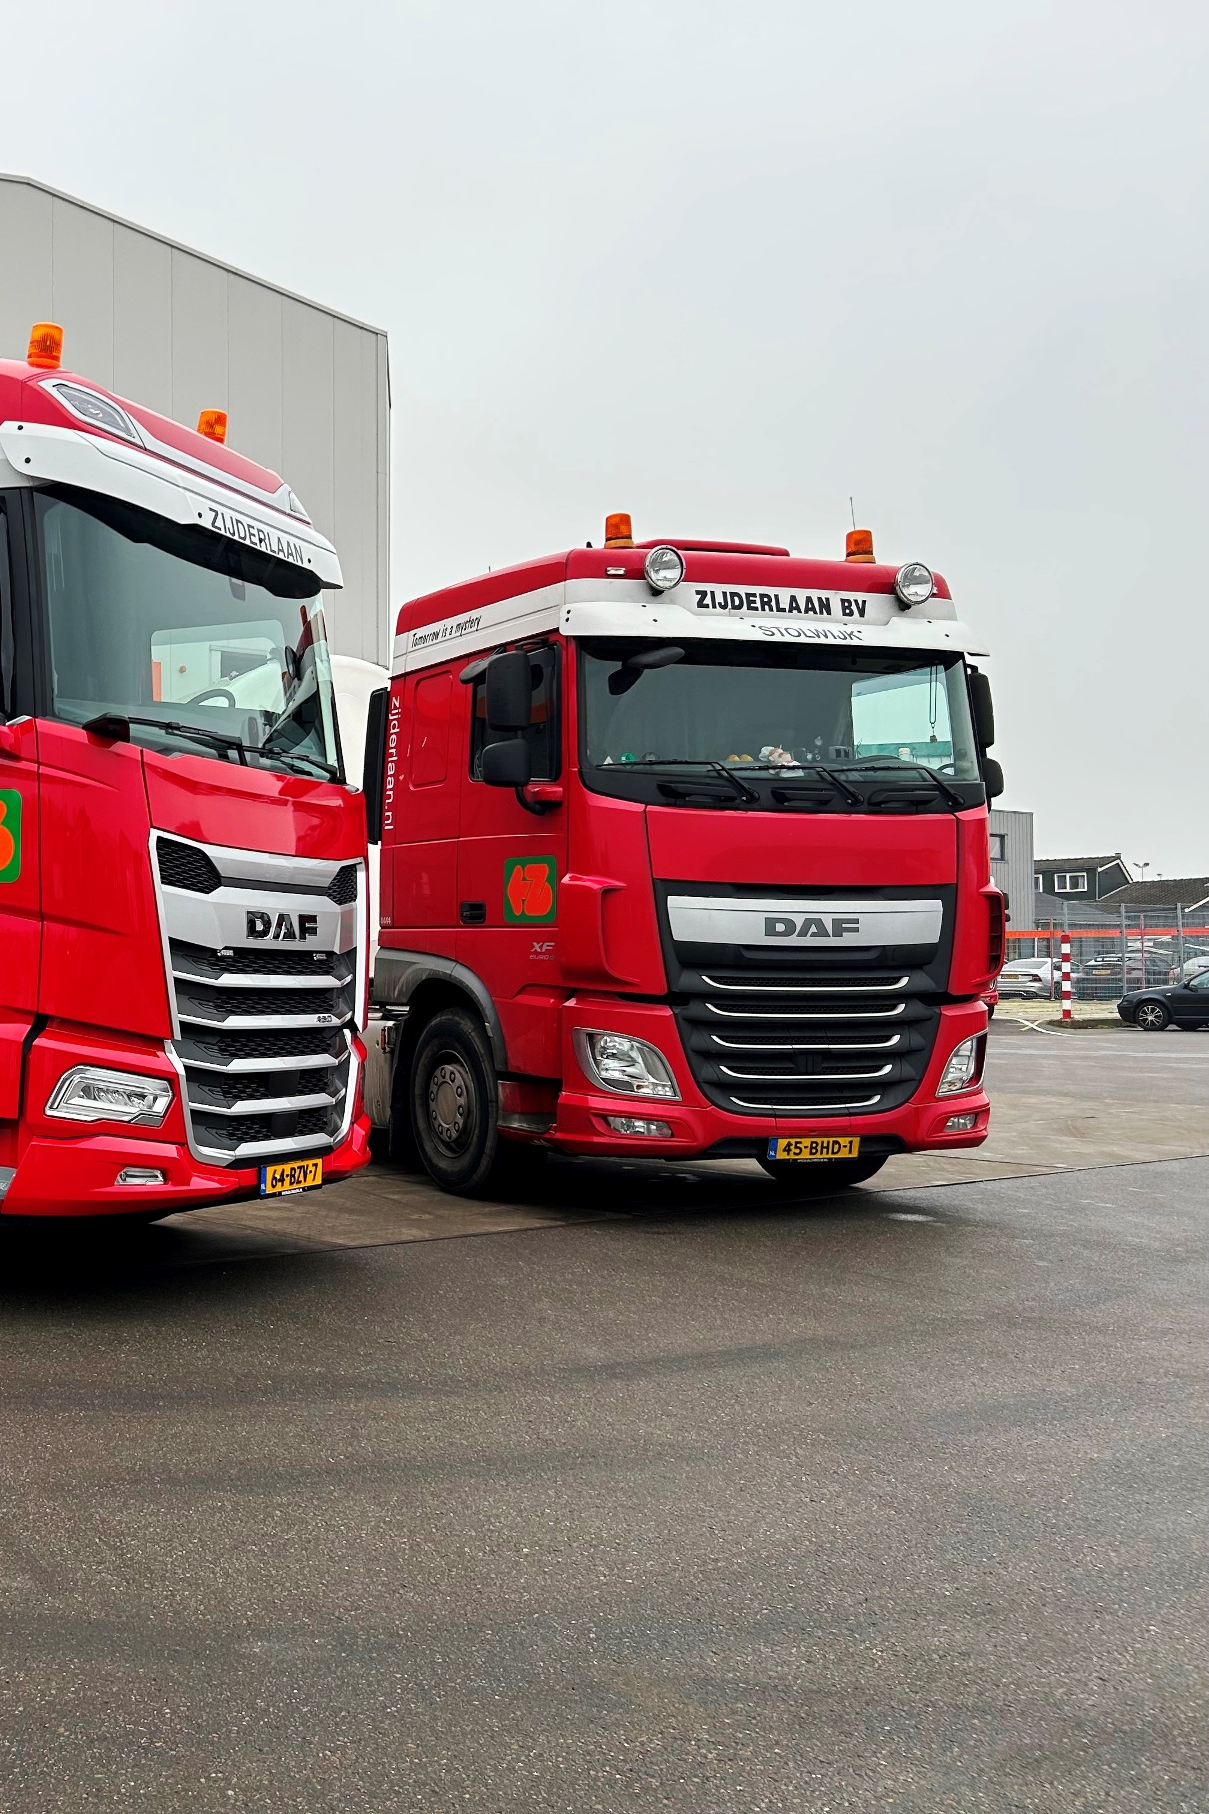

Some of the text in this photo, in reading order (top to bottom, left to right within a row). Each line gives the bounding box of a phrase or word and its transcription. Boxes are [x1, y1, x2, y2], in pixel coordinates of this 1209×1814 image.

[208, 506, 304, 565] ZIJDERLAAN
[695, 589, 867, 618] ZIJDERLAAN BV
[411, 629, 442, 648] Tomorrow
[441, 624, 447, 638] is
[455, 615, 482, 637] mystery
[758, 625, 864, 641] STOLWIJK
[384, 696, 402, 830] zijderlaan.nl
[245, 910, 318, 942] DAF
[764, 917, 860, 937] DAF
[530, 942, 555, 952] XF
[782, 1140, 854, 1156] 45-BHD-1
[271, 1163, 318, 1188] 64-BZV-7
